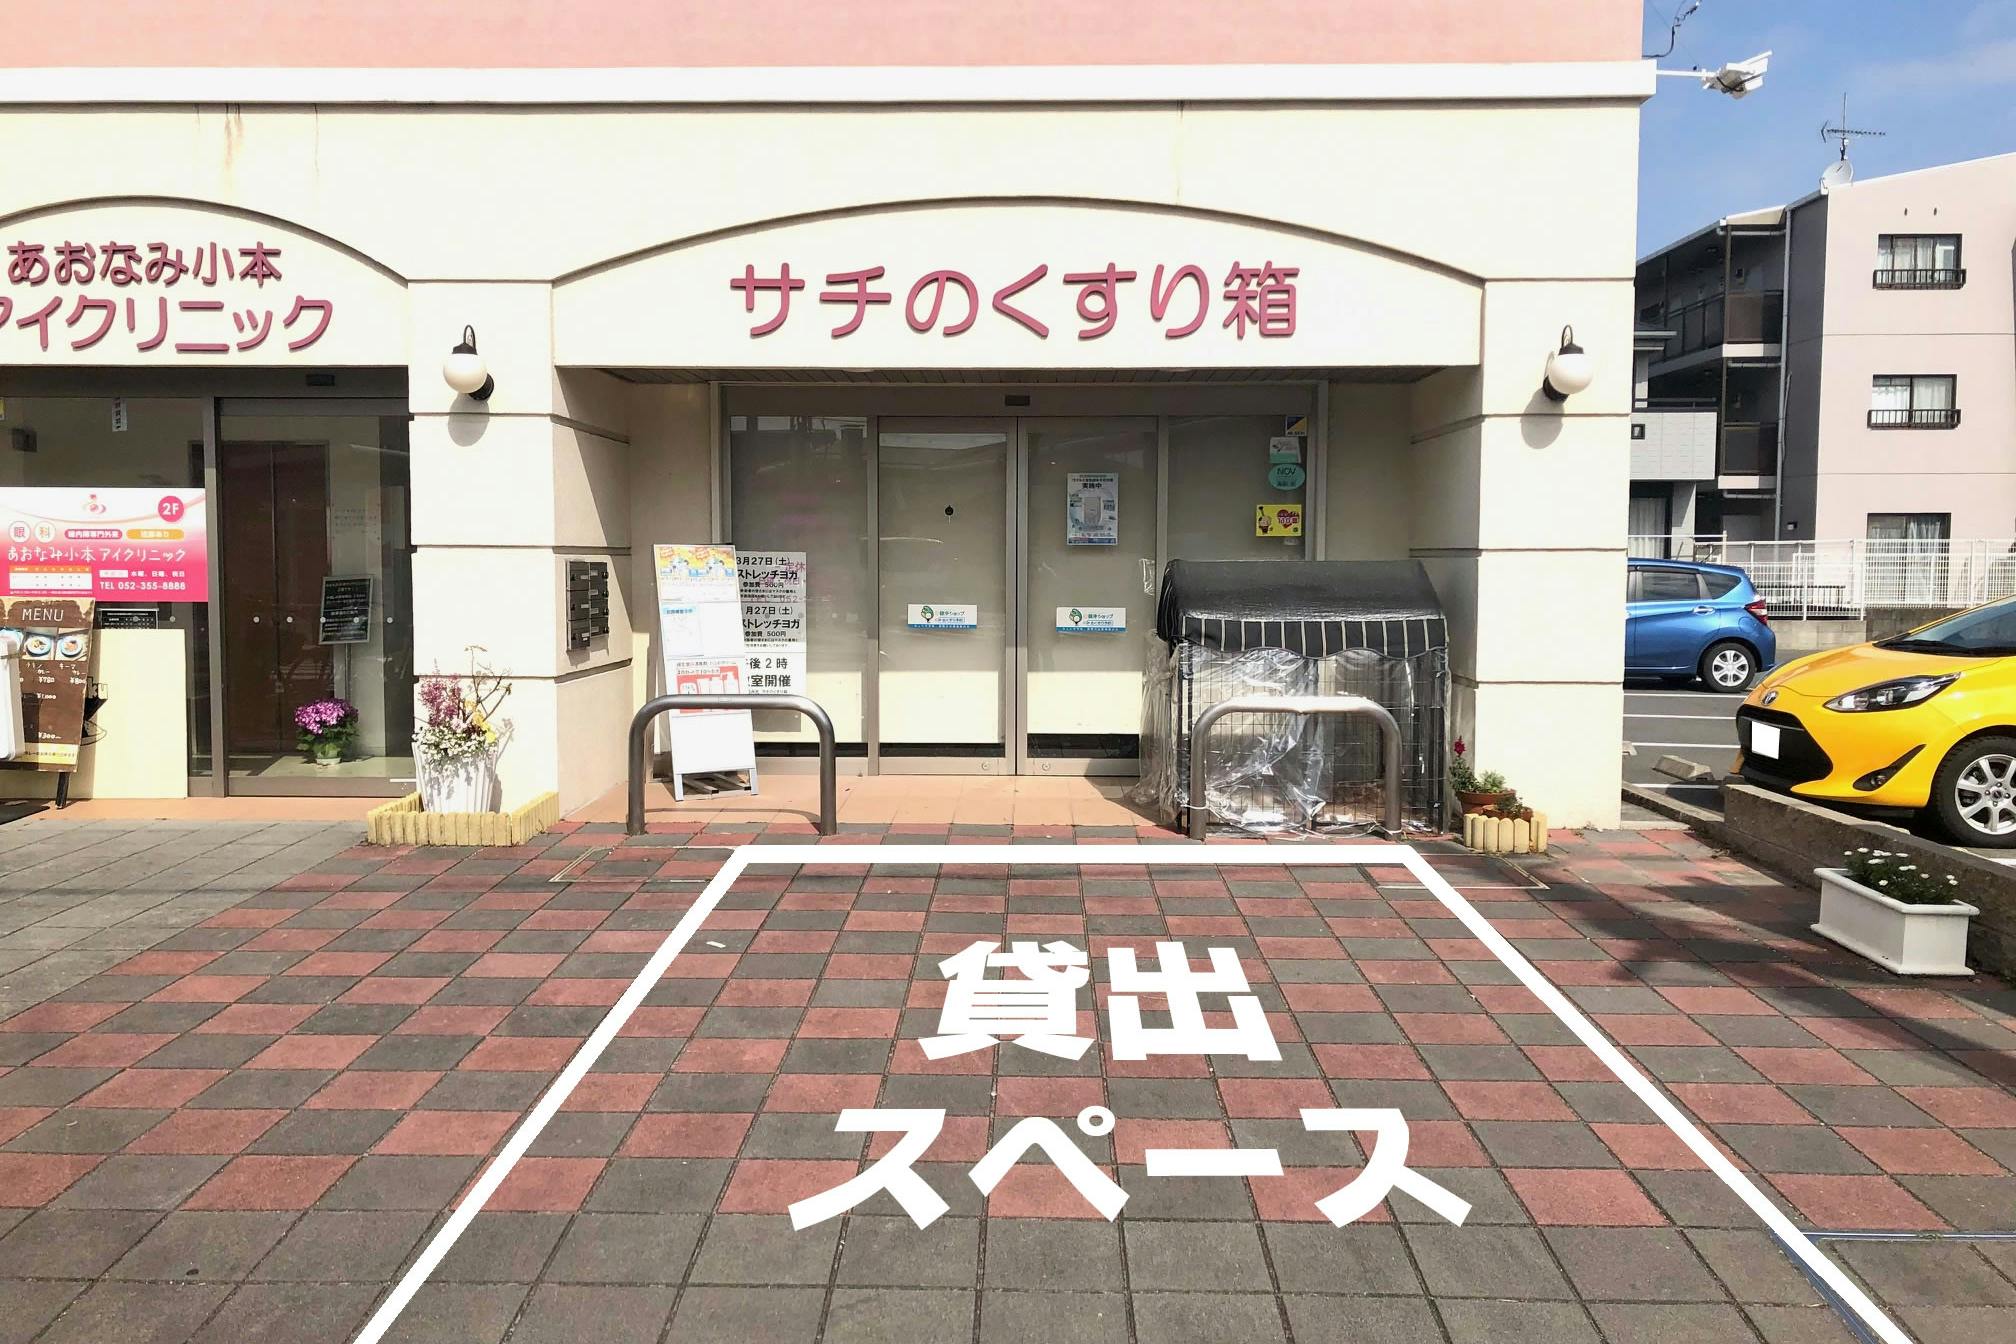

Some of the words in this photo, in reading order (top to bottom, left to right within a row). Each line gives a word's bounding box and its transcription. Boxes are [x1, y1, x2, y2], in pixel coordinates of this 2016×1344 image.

[7, 240, 283, 287] あおなみ小本
[730, 260, 1301, 339] サチのくすり箱
[162, 502, 180, 516] 2F
[8, 546, 96, 563] あおなみ小本
[101, 547, 186, 562] アイクリニック
[737, 569, 798, 580] ストレッチヨガ
[100, 581, 115, 591] TEL
[22, 608, 64, 621] MENU
